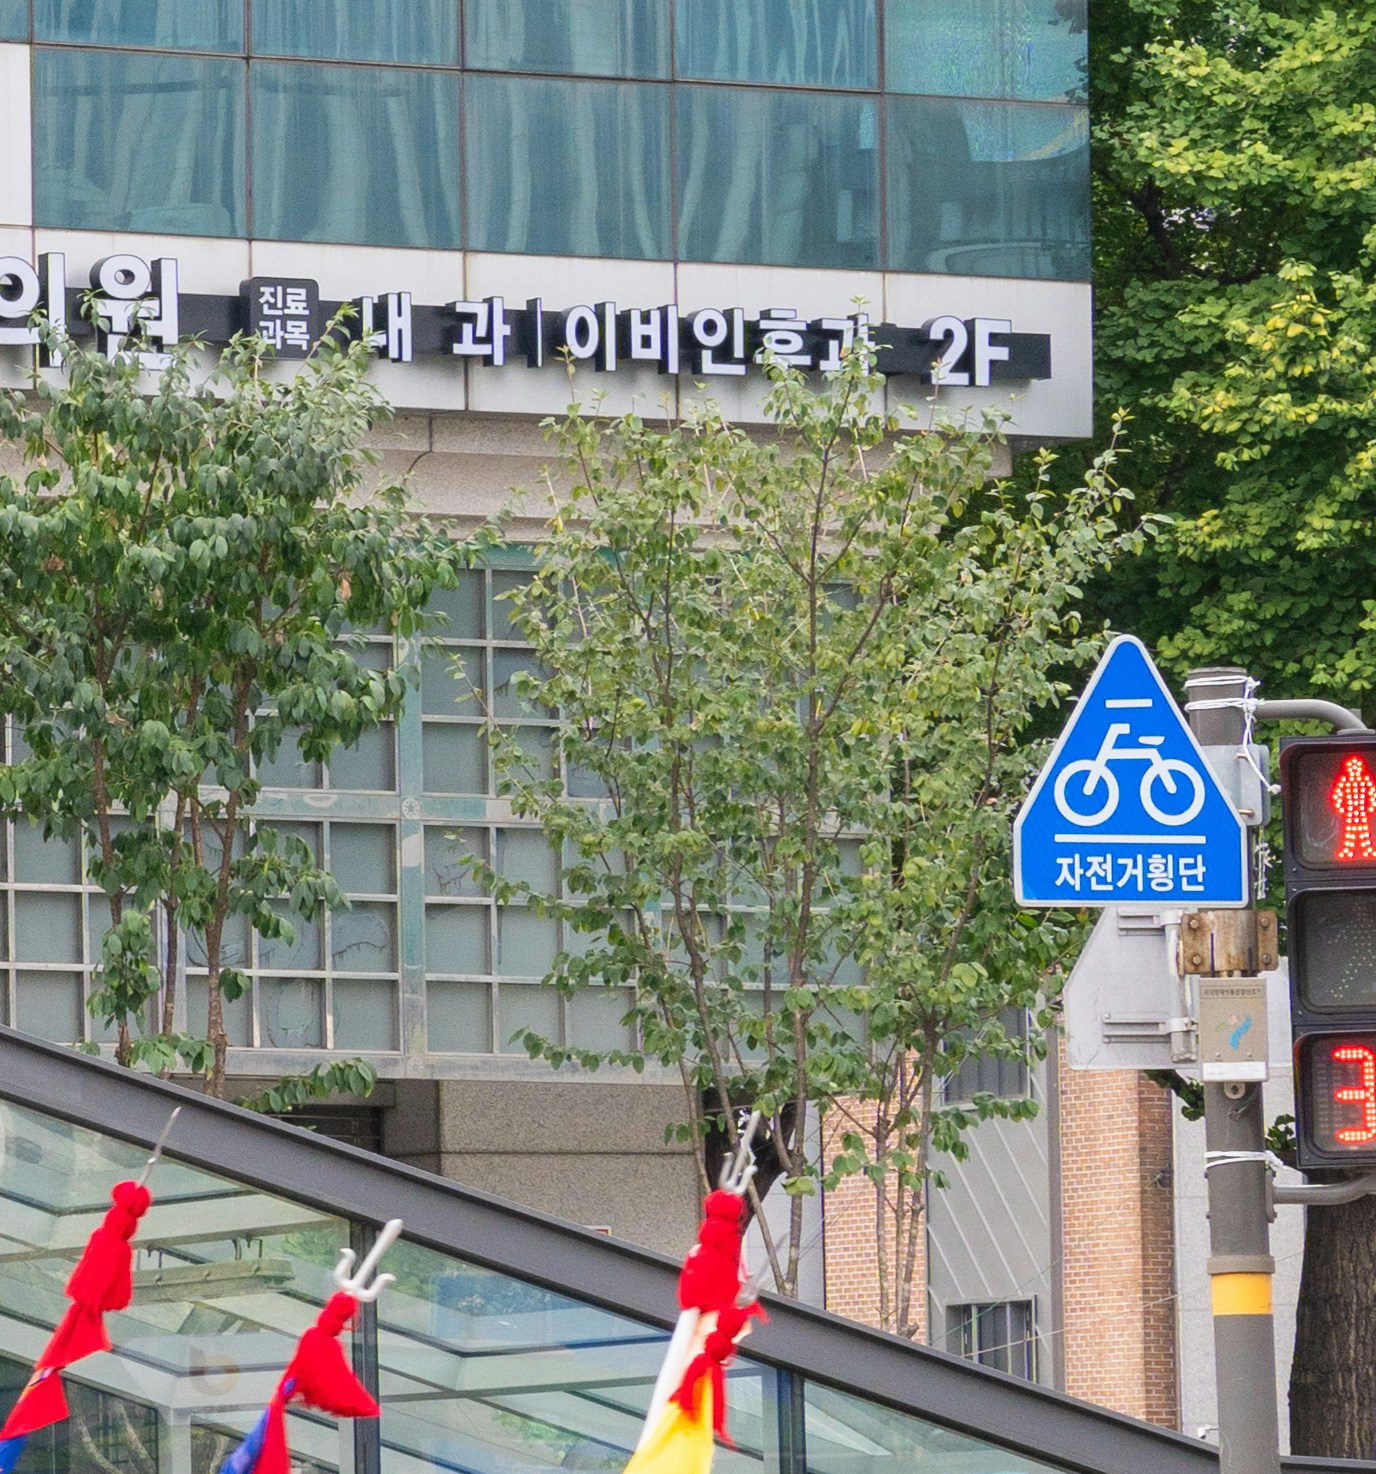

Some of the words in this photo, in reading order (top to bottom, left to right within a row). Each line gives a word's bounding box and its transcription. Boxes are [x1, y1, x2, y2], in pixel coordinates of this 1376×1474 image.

[258, 285, 310, 317] 진료
[261, 319, 311, 354] 과목
[565, 301, 876, 377] 이비인후과
[930, 316, 1012, 386] 2F
[1054, 853, 1207, 893] 자전거횡단
